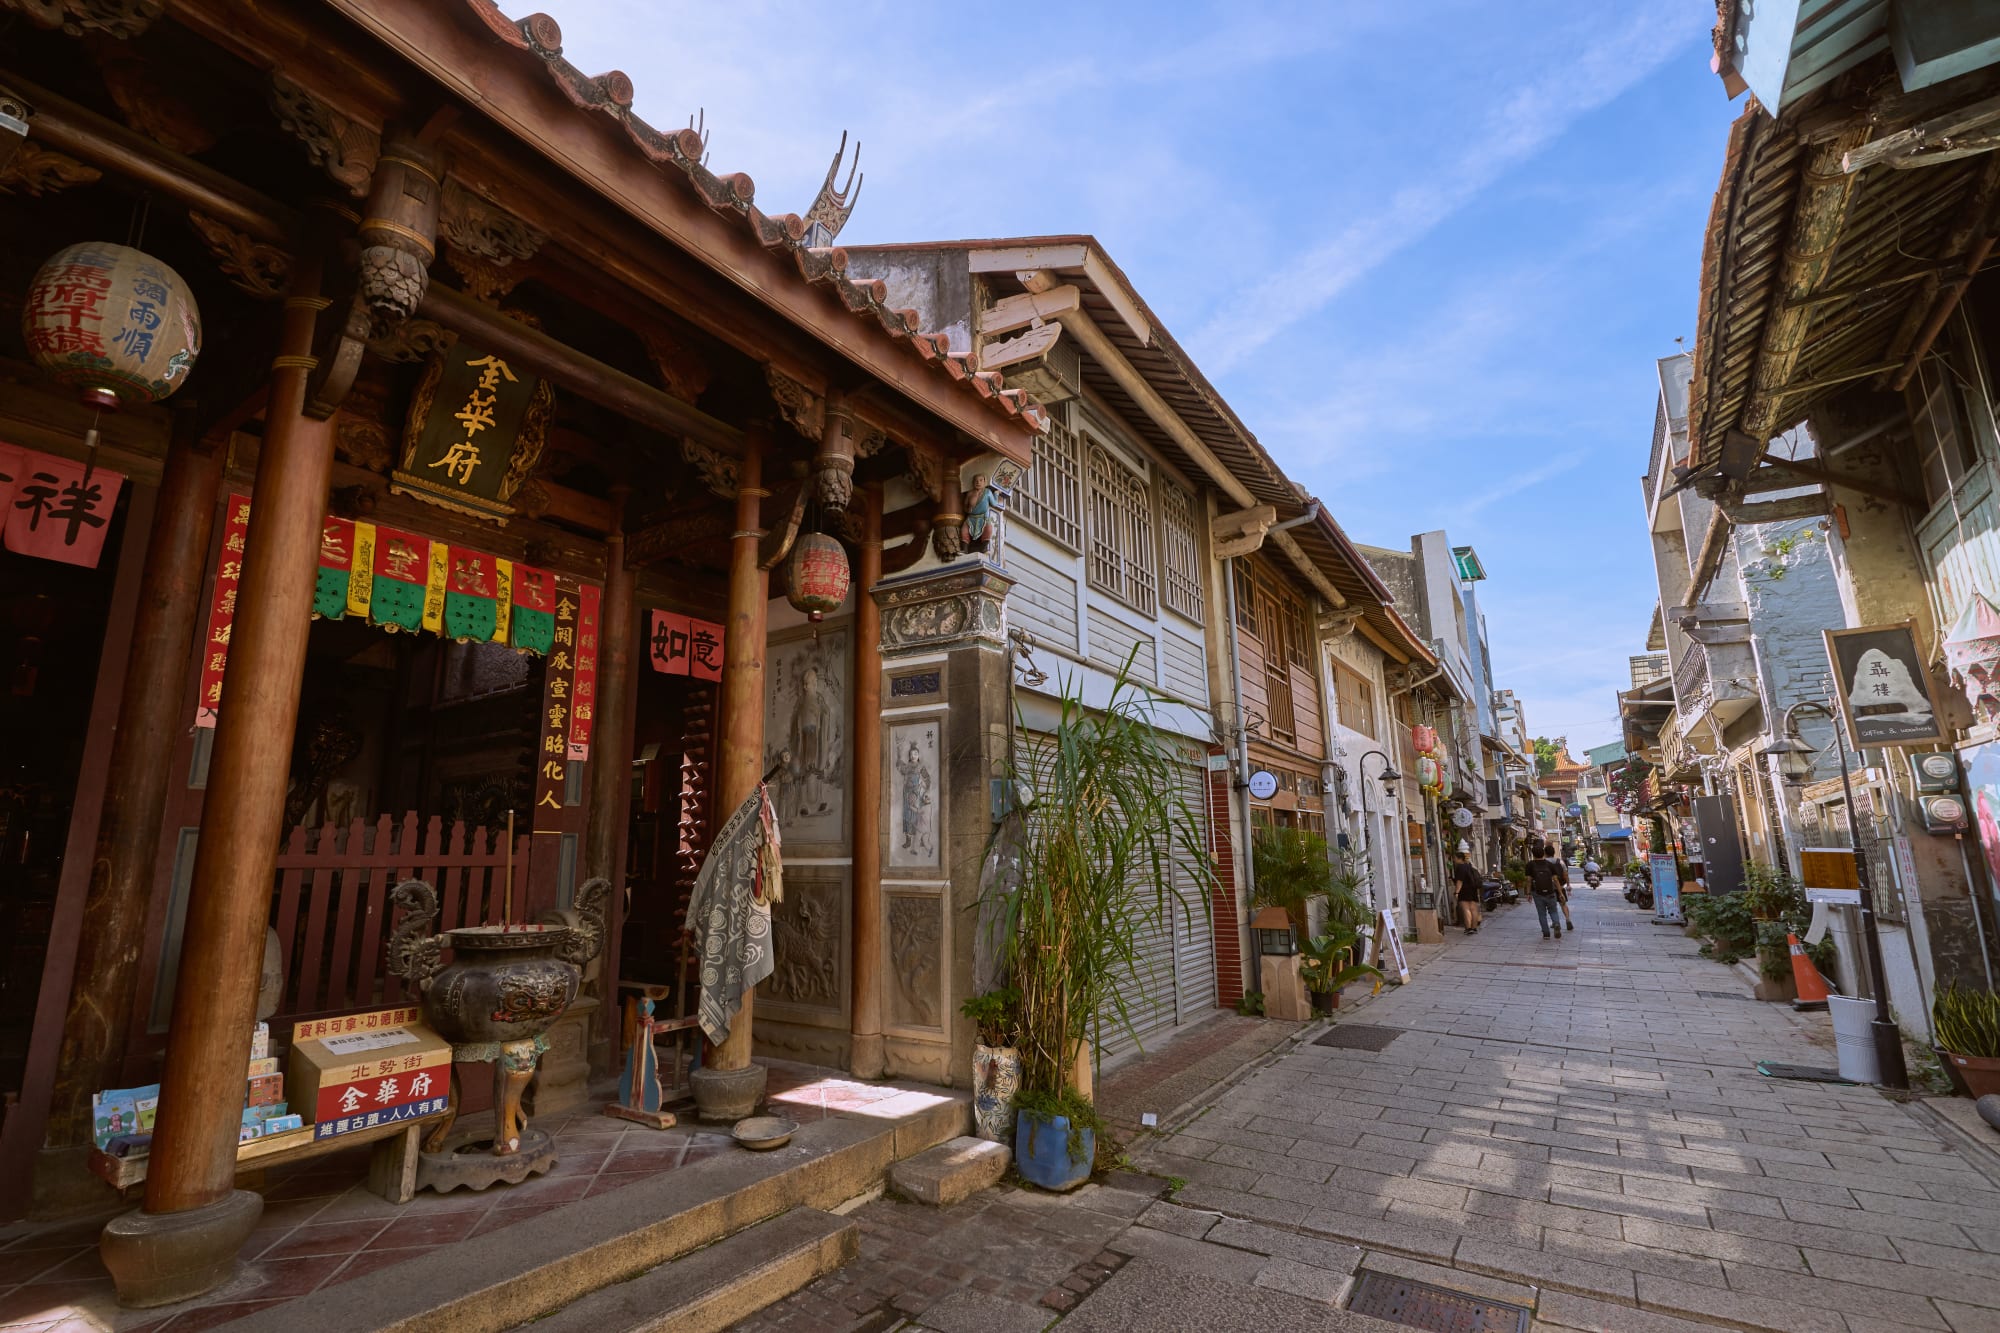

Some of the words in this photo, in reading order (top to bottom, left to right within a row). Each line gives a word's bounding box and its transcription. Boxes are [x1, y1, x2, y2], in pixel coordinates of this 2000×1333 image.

[111, 262, 173, 364] 風調雨順
[427, 354, 520, 485] 金華府
[0, 472, 106, 545] 祥
[652, 620, 722, 672] 如意
[337, 1072, 433, 1113] 金華府
[350, 1055, 423, 1080] 北勢街
